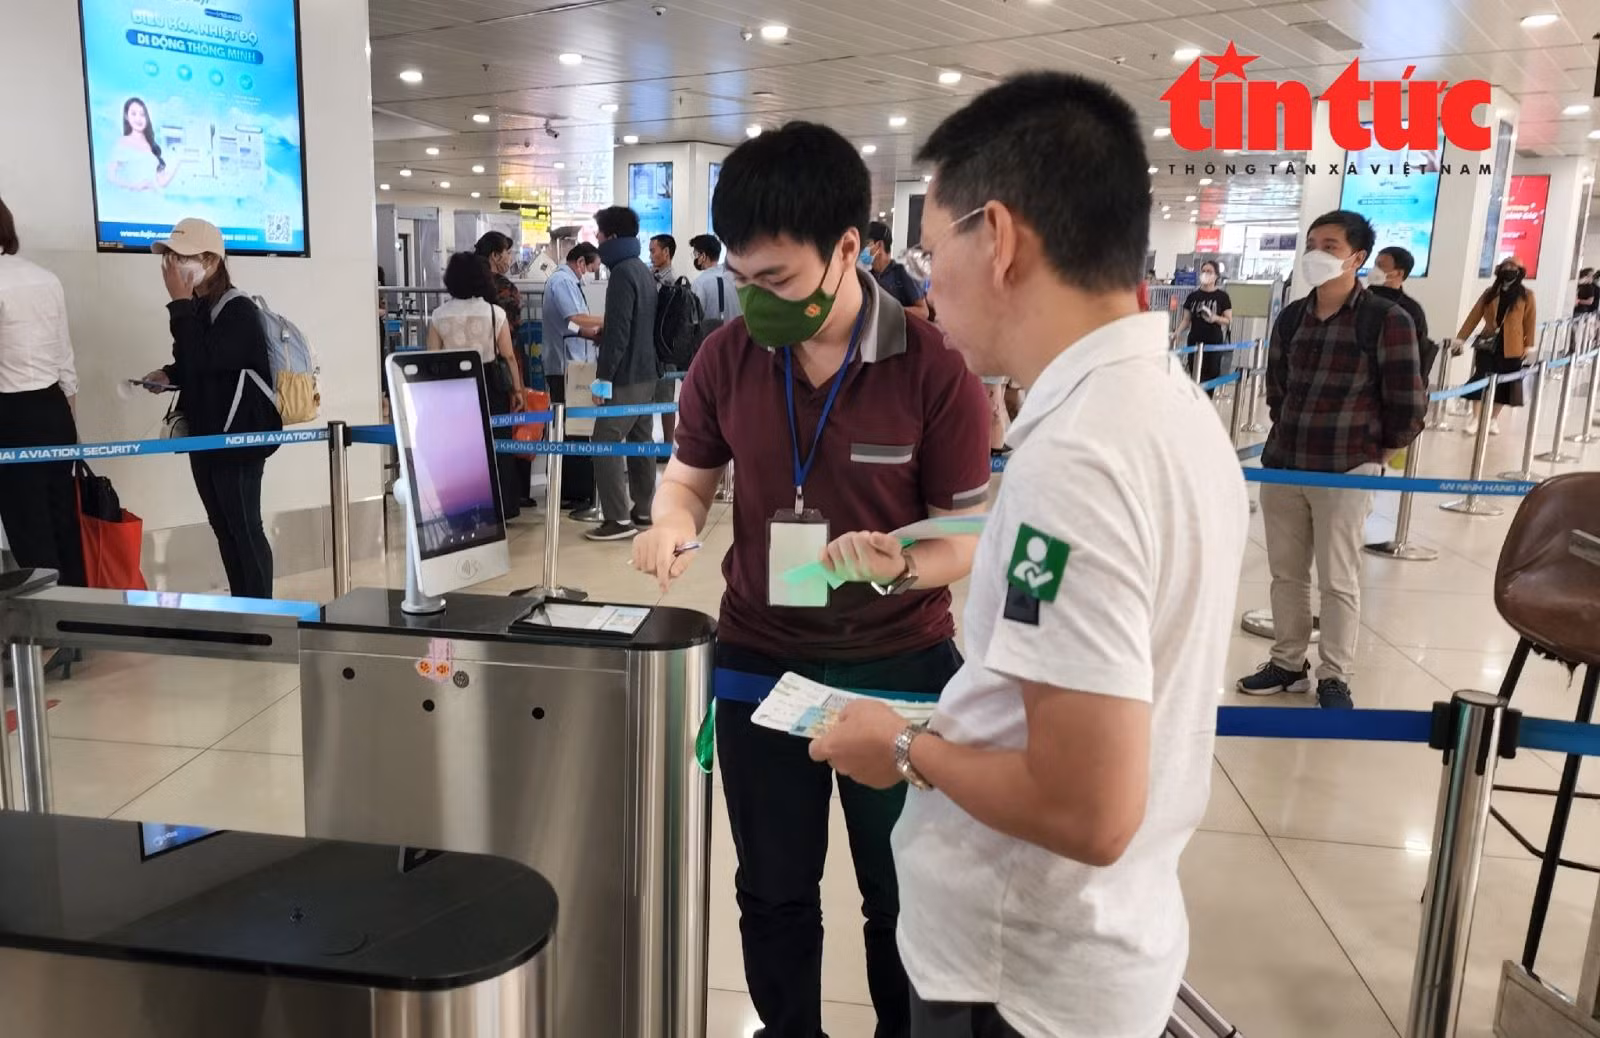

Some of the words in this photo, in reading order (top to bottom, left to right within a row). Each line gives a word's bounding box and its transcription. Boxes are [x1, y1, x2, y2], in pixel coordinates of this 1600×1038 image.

[247, 435, 264, 444] BAI
[267, 431, 317, 442] AVIATION
[19, 447, 80, 459] AVIATION
[83, 443, 140, 456] SECURITY
